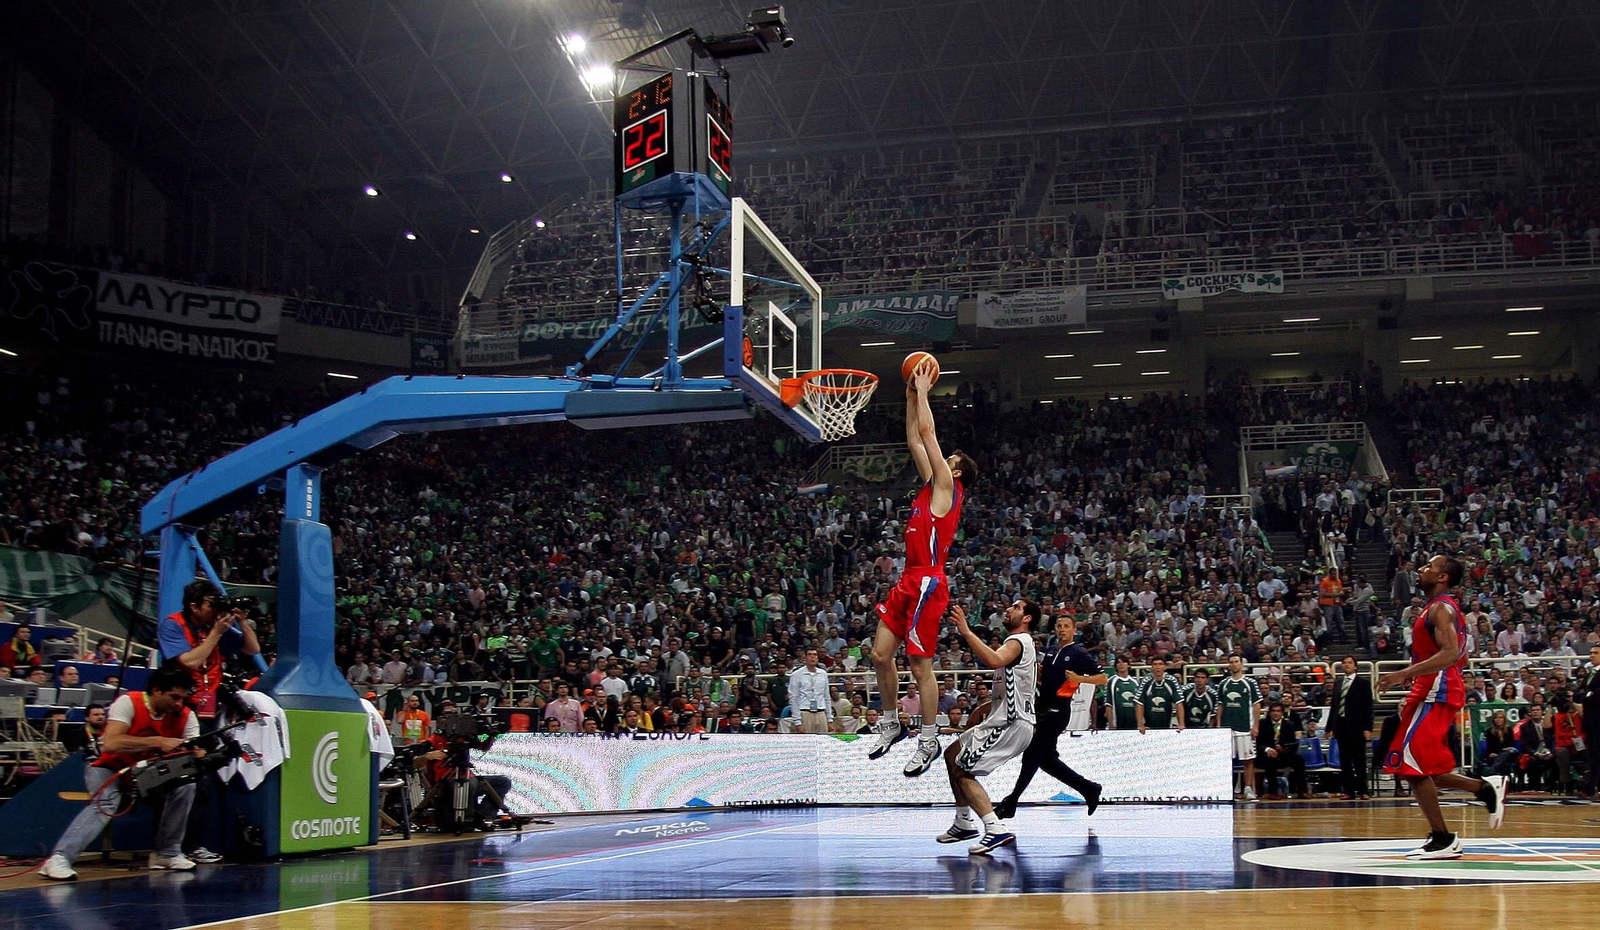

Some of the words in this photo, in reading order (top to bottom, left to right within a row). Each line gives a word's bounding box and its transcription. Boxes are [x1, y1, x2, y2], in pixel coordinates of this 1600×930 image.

[629, 76, 672, 119] 2:12
[625, 114, 665, 167] 22
[1187, 273, 1256, 288] COCKNEYS
[1200, 283, 1242, 294] ATHENS
[100, 279, 261, 323] ΛΑΥΡΙΟ
[1039, 314, 1068, 324] GROUP
[291, 816, 361, 840] COSMOTE
[614, 820, 706, 836] NOKIA
[655, 826, 711, 838] Nseries
